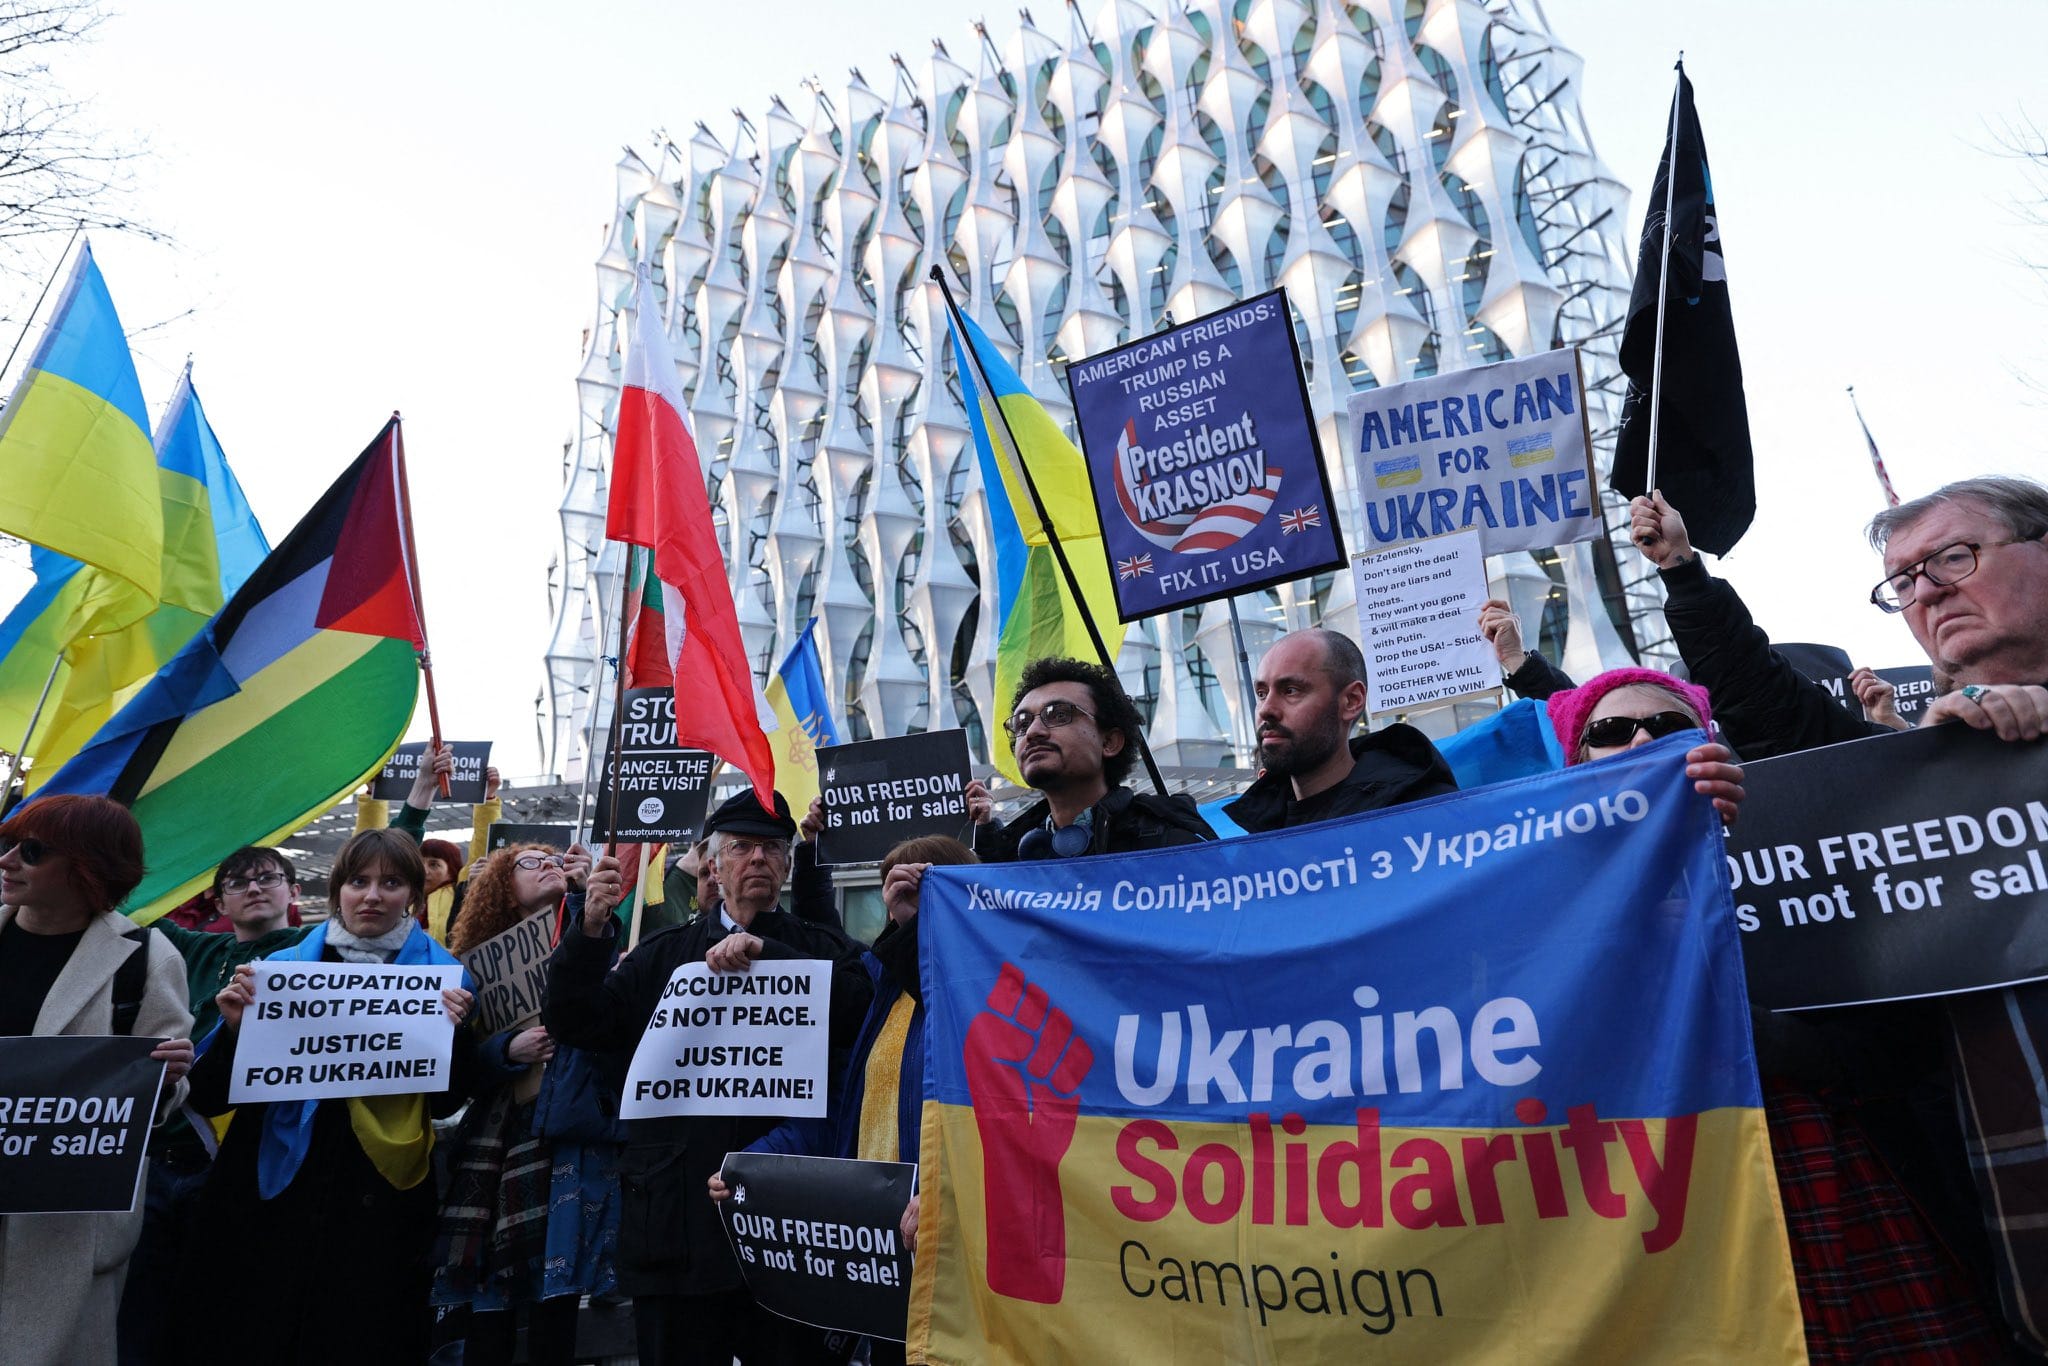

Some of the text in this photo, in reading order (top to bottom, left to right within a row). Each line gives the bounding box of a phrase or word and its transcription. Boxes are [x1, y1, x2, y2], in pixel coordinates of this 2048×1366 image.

[1077, 304, 1276, 386] AMERICAN FRIENDS:
[1120, 344, 1232, 394] TRUMP IS A
[1139, 370, 1226, 412] RUSSIAN
[1154, 397, 1217, 431] ASSET
[1361, 373, 1575, 452] AMERICAN
[1128, 410, 1257, 482] President
[1438, 445, 1490, 476] FOR
[1133, 451, 1266, 524] KRASNOV
[1366, 470, 1590, 542] UKRAINE
[1159, 546, 1284, 594] FIX IT, USA
[1362, 546, 1422, 566] Mr Zelensky,
[1392, 563, 1412, 574] sign
[1414, 558, 1431, 568] the
[1433, 551, 1458, 563] deal!
[1366, 569, 1452, 596] They are liars and
[1368, 597, 1404, 610] cheats.
[1369, 592, 1466, 621] They want you gone
[1380, 622, 1398, 634] will
[1400, 617, 1428, 628] make
[1430, 614, 1436, 622] a
[1438, 608, 1462, 620] deal
[1373, 632, 1426, 650] with Putin.
[1376, 652, 1400, 663] Drop
[1402, 647, 1418, 658] the
[1420, 642, 1445, 654] USA!
[1454, 634, 1482, 646] Stick
[1377, 660, 1440, 678] with Europe.
[1378, 666, 1482, 693] TOGETHER WE WILL
[1381, 680, 1485, 708] FIND A WAY TO WIN!
[630, 697, 676, 720] STO
[622, 723, 678, 745] TRU
[676, 760, 709, 774] THE
[662, 776, 704, 790] VISIT
[824, 773, 962, 806] OUR FREEDOM
[827, 794, 965, 828] is not for sale!
[605, 828, 692, 838] ww.stoptrump.org.uk
[1112, 847, 1360, 914] Солідарності
[1370, 851, 1394, 879] з
[1402, 788, 1651, 874] Україною
[1736, 849, 2048, 932] s not for sal
[468, 909, 553, 991] SUPPORT
[268, 974, 442, 991] OCCUPATION
[664, 976, 810, 999] OCCUPATION
[258, 999, 443, 1020] IS NOT PEACE.
[650, 1006, 816, 1029] IS NOT PEACE.
[290, 1032, 403, 1056] JUSTICE
[676, 1046, 784, 1067] JUSTICE
[1114, 986, 1542, 1106] Ukraine
[246, 1059, 436, 1086] FOR UKRAINE!
[636, 1078, 814, 1101] FOR UKRAINE!
[0, 1097, 134, 1124] REEDOM
[50, 1128, 128, 1156] sale!
[1110, 1098, 1699, 1254] Solidarity
[732, 1212, 896, 1256] OUR FREEDOM
[738, 1238, 900, 1287] is not for sale!
[1120, 1241, 1444, 1334] Campaign
